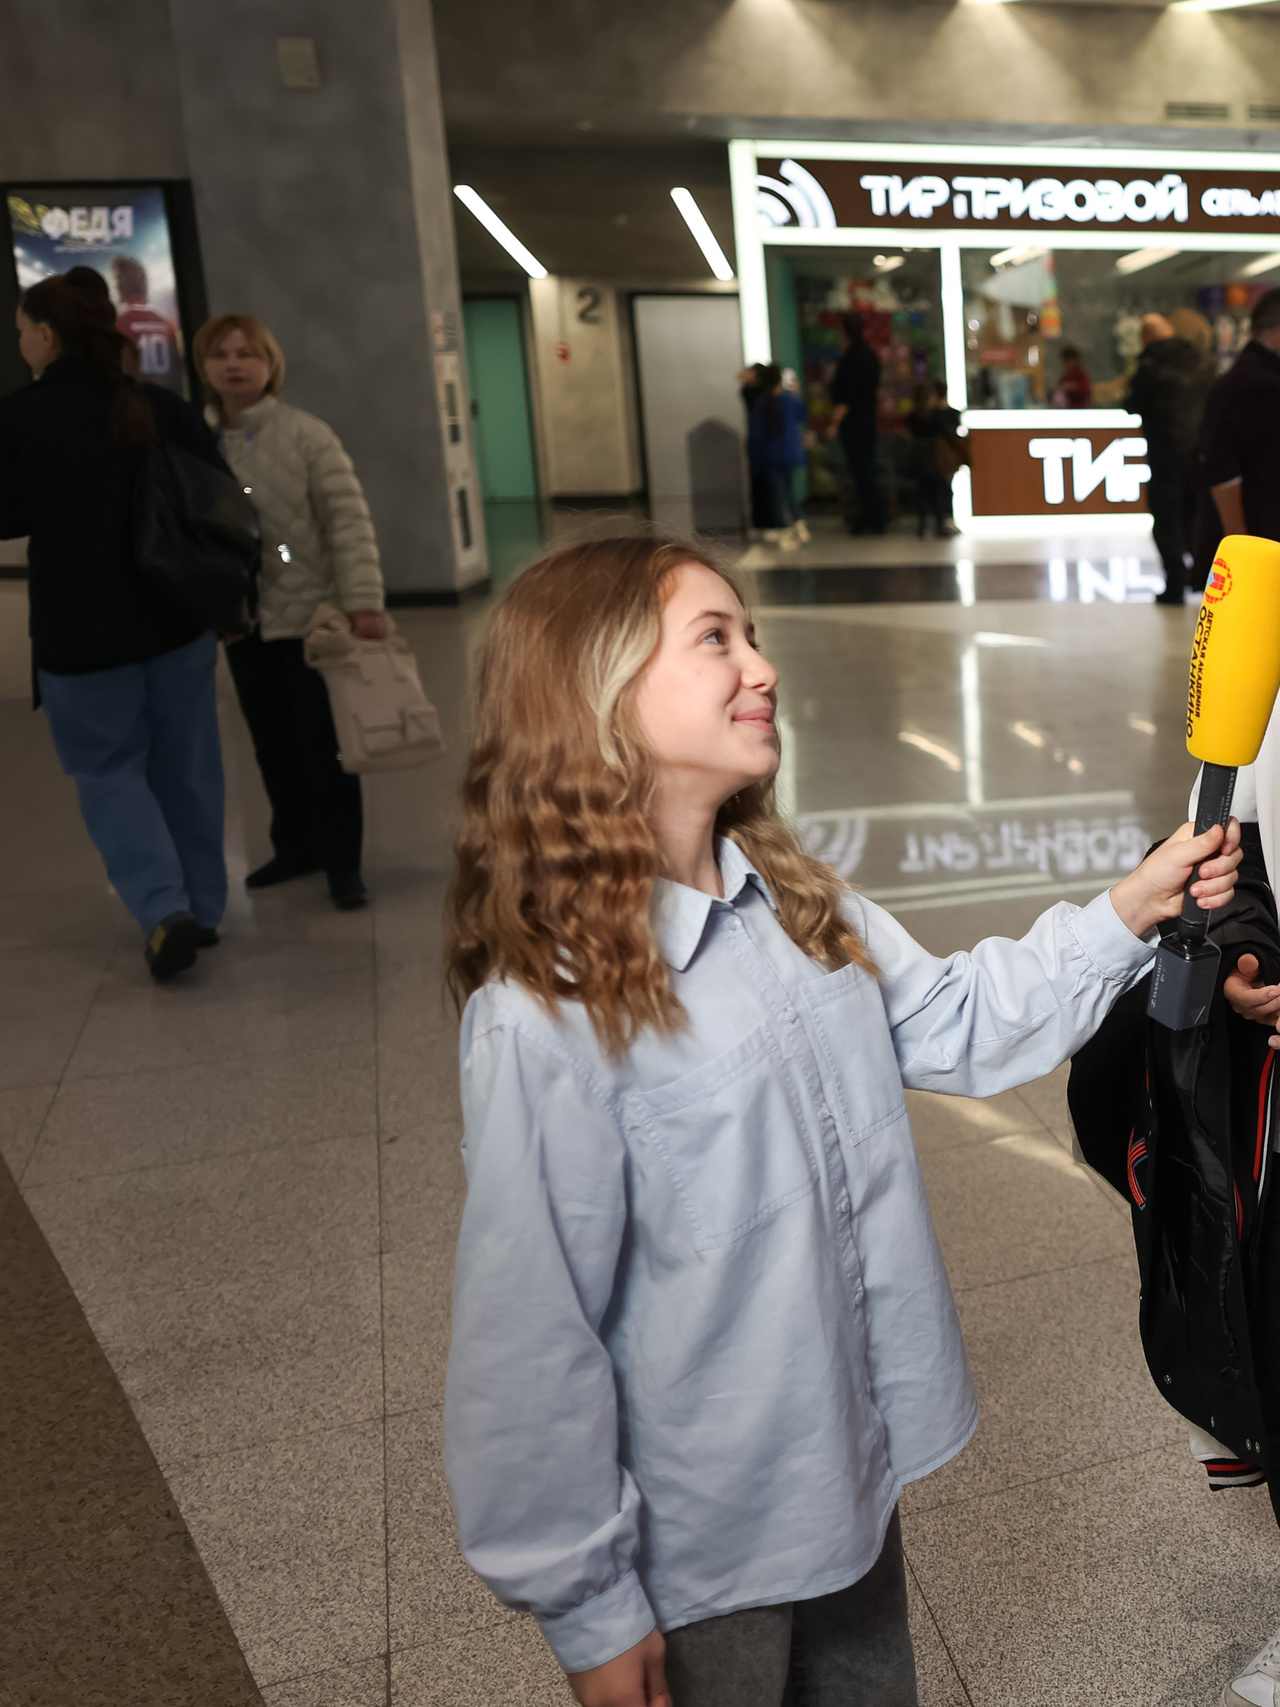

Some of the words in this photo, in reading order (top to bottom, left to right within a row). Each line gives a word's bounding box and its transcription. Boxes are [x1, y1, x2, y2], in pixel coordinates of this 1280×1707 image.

[859, 174, 950, 219] ТИР
[952, 173, 1189, 222] ПРИЗОВОЙ
[41, 205, 134, 243] ФЕДЯ
[576, 286, 601, 324] 2
[138, 334, 171, 374] 10
[1200, 609, 1214, 659] ДЕТСКАЯ
[1187, 605, 1207, 738] ОСТАНКИНО
[1194, 659, 1204, 719] АКАДЕМИЯ
